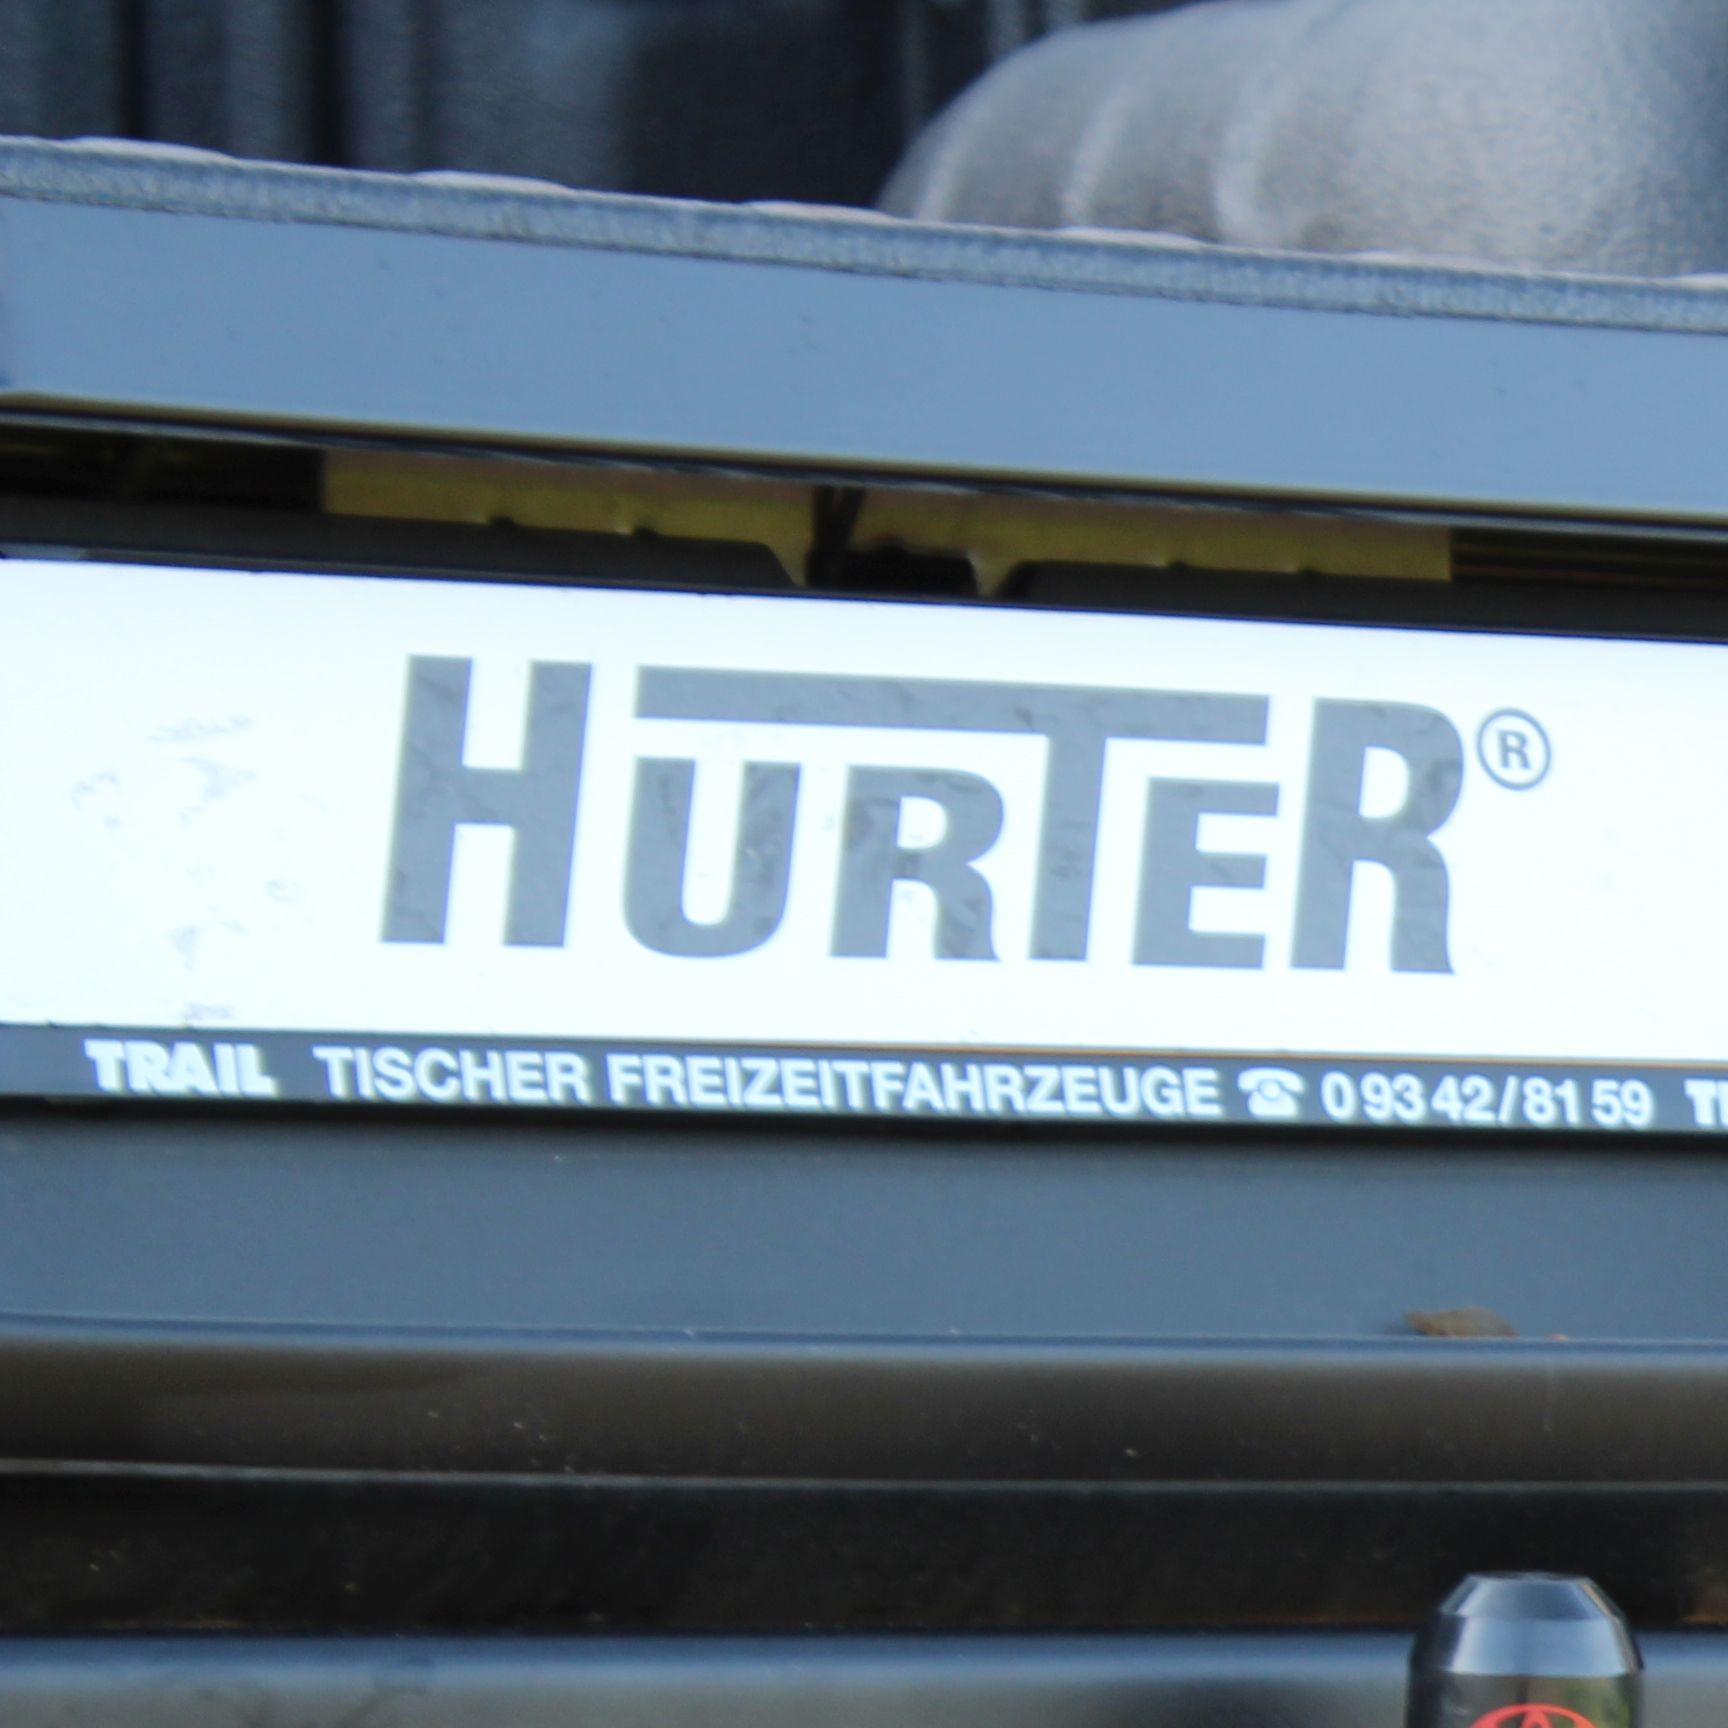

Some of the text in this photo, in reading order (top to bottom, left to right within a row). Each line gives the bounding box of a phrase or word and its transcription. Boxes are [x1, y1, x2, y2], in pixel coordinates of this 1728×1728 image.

[84, 1039, 276, 1095] TRAIL
[313, 1045, 590, 1103] TISCHER
[606, 1053, 1223, 1118] FREIZEITFAHRZEUGE
